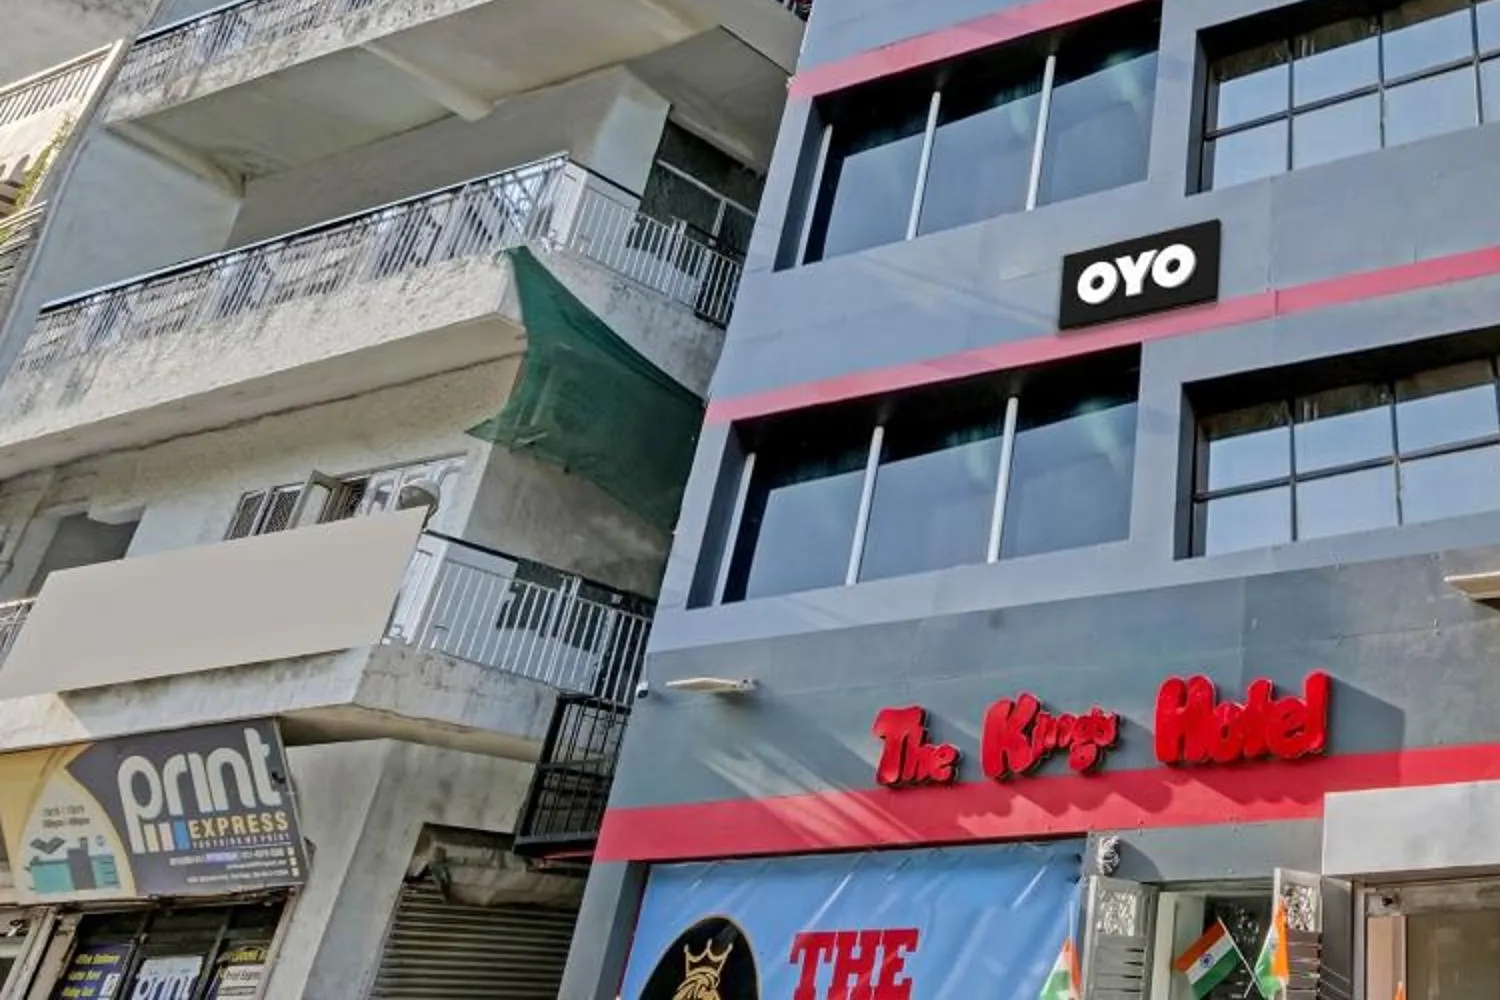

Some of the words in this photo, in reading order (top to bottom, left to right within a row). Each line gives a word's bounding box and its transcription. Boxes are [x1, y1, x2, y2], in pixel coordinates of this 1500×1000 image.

[1077, 243, 1197, 305] OYO
[872, 705, 961, 786] The
[1155, 668, 1332, 765] Hotel
[117, 727, 281, 854] print
[189, 812, 289, 838] EXPRESS
[790, 928, 920, 1000] THE
